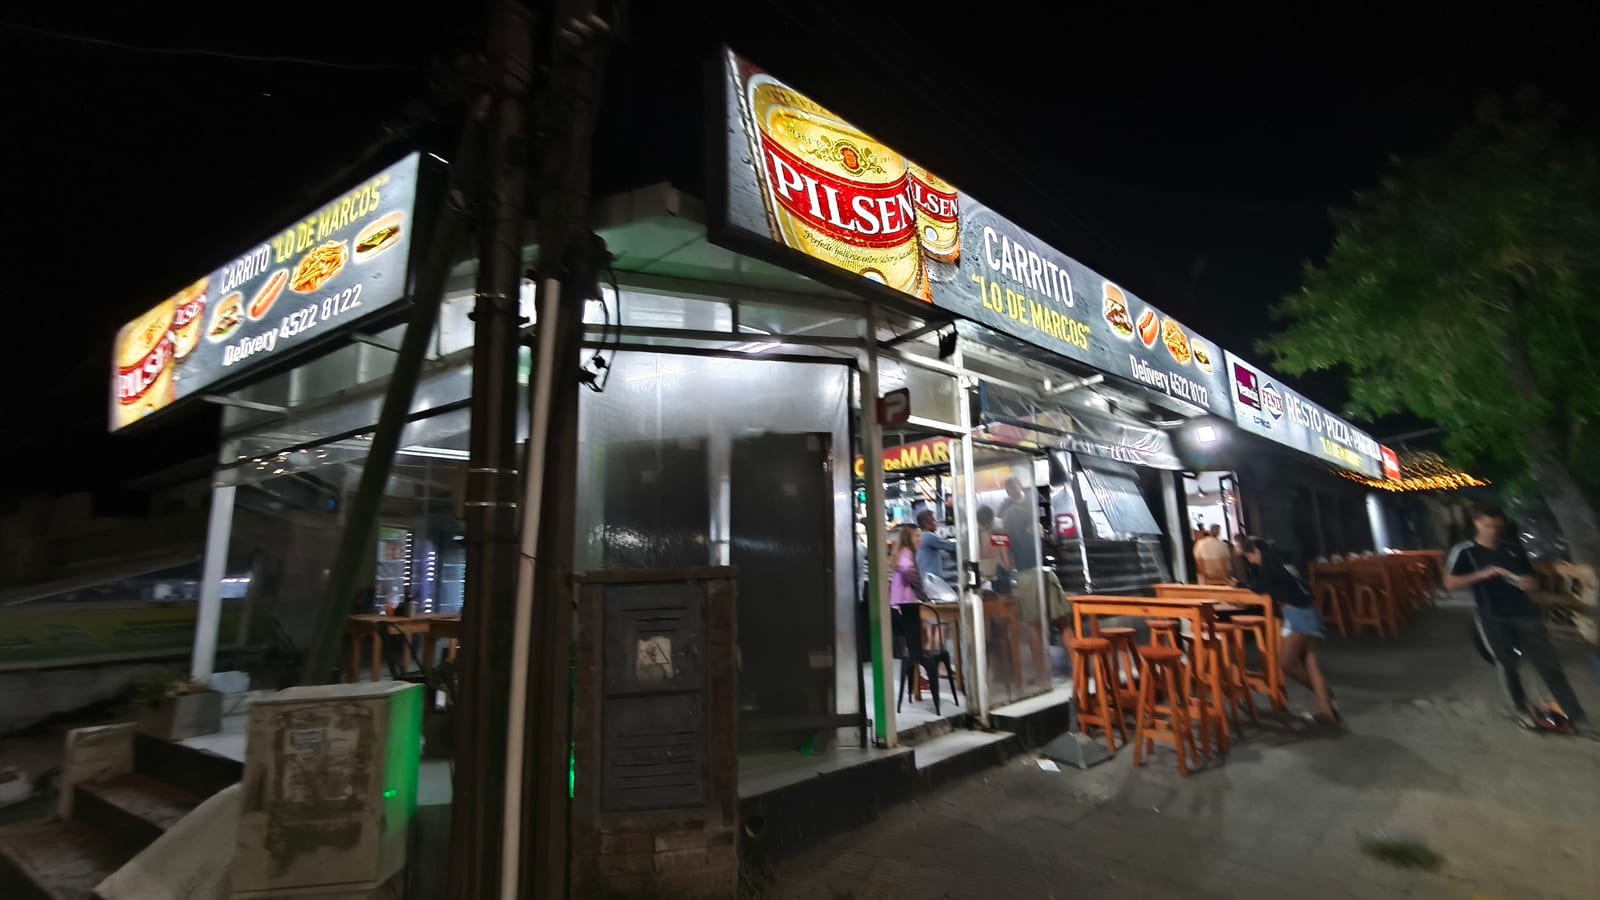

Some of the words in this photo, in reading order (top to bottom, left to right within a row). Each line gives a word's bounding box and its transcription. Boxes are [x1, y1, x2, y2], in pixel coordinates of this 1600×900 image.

[768, 150, 916, 236] PILSEN
[913, 182, 958, 217] LSEN
[220, 243, 271, 295] CARRITO
[296, 217, 317, 253] DE
[983, 226, 1074, 308] CARRITO
[222, 328, 279, 366] Delivery
[279, 304, 318, 338] 4522
[321, 283, 363, 320] 8122
[1006, 288, 1028, 325] DE
[1129, 353, 1171, 396] Delivery
[1285, 391, 1322, 433] RESTO
[1323, 413, 1353, 447] PIZZA
[901, 441, 951, 468] MAR
